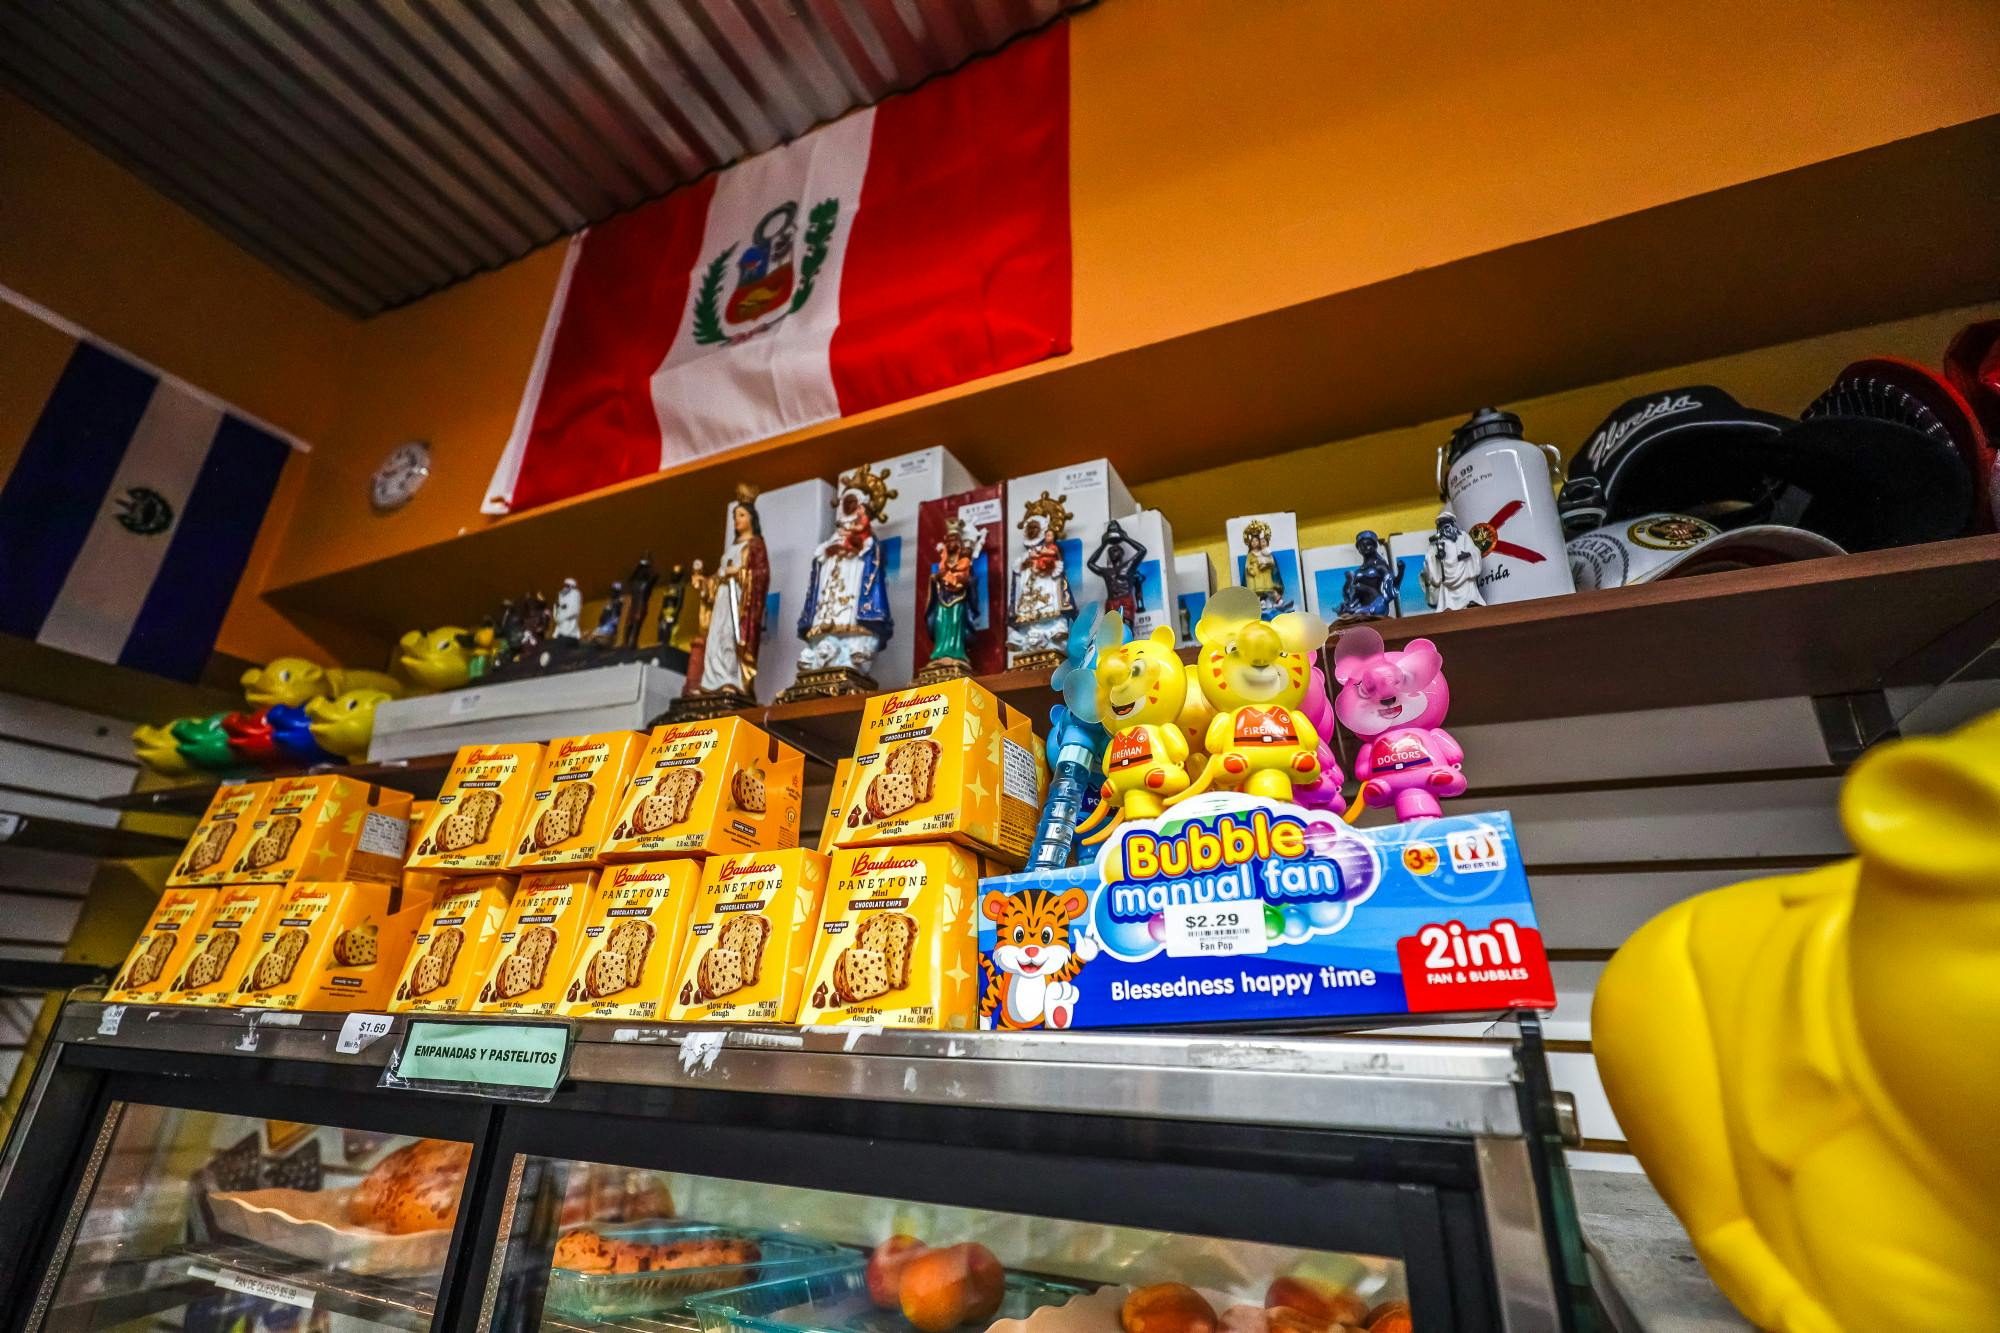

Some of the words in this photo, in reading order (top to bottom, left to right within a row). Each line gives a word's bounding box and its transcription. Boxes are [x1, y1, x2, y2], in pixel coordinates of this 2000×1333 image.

[1587, 393, 1704, 472] Florida
[881, 693, 942, 717] Bauducco
[870, 706, 950, 729] PANETTONE
[1243, 726, 1289, 736] FIREMAN
[650, 740, 718, 755] PANETTONE
[1112, 746, 1143, 760] FIREMAN
[548, 754, 609, 769] PANETTONE
[1377, 751, 1421, 765] DOCTORS
[455, 765, 518, 775] PANETTONE
[1127, 811, 1307, 879] Bubble
[850, 851, 919, 877] Bauducco
[1407, 848, 1437, 870] 3+
[612, 866, 665, 888] Bauducco
[719, 857, 777, 882] Bauducco
[707, 879, 783, 894] PANETTONE
[838, 875, 928, 890] PANETTONE
[1115, 862, 1252, 913] manual
[1263, 859, 1335, 895] fan
[601, 888, 670, 900] PANETTONE
[871, 889, 888, 897] Mini
[515, 896, 573, 908] PANETTONE
[1185, 913, 1240, 929] $2.29
[1200, 942, 1215, 951] Fan
[1217, 941, 1234, 951] Pop
[1420, 922, 1522, 969] 2in1
[1111, 975, 1235, 1001] Blessedness
[1240, 970, 1314, 997] happy
[1319, 966, 1377, 989] time
[1427, 973, 1453, 985] FAN
[1456, 972, 1467, 983] &
[1469, 968, 1529, 983] BUBBLES
[359, 1021, 386, 1034] $1.69
[414, 1045, 477, 1060] EMPANADAS
[479, 1049, 488, 1060] Y
[488, 1049, 557, 1064] PASTELITOS
